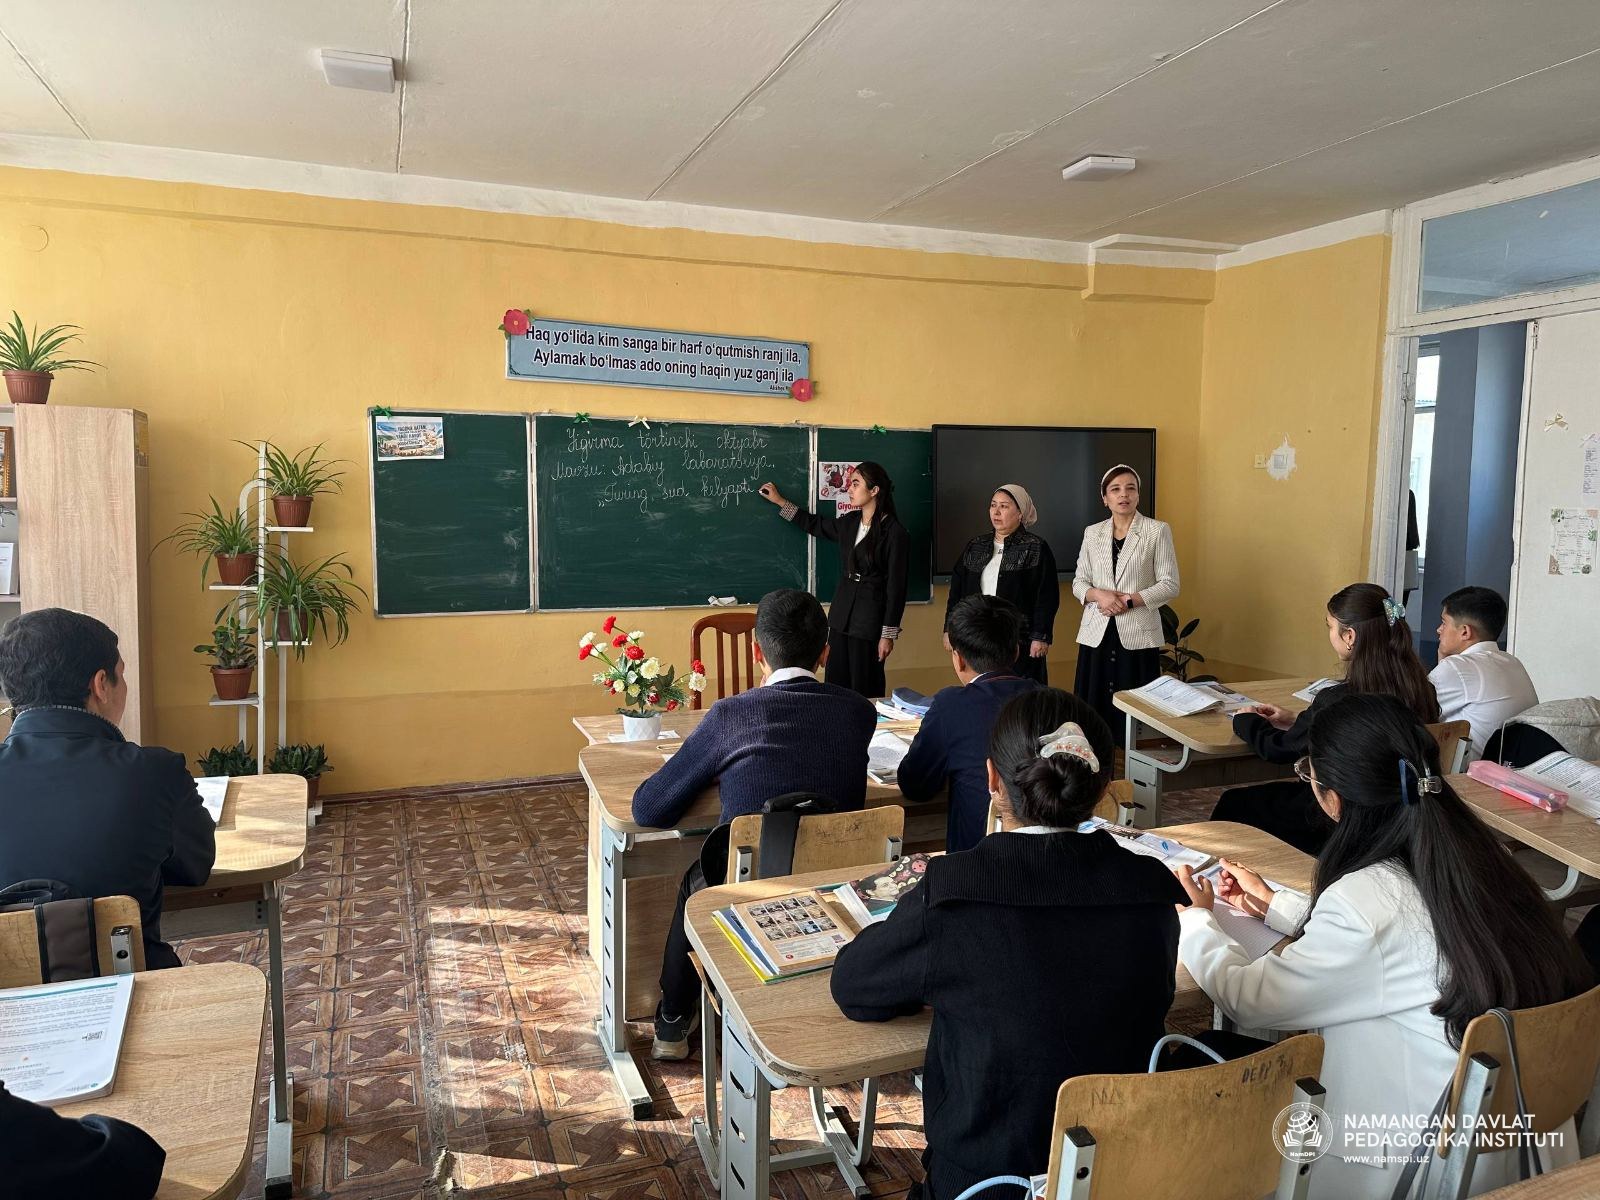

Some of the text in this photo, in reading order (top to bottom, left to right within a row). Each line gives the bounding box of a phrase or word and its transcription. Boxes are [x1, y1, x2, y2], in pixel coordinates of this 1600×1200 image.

[526, 326, 550, 345] Haq
[598, 332, 619, 347] kim
[622, 336, 658, 353] sanga
[661, 338, 676, 352] bir
[680, 340, 703, 355] harf
[762, 349, 783, 364] ranj
[786, 349, 801, 364] ila,
[533, 348, 587, 366] Aylamak
[640, 358, 662, 372] ado
[665, 361, 697, 378] oning
[700, 362, 731, 379] haqin
[734, 367, 753, 381] yuz
[756, 368, 779, 384] ganj
[782, 368, 794, 382] ila
[566, 428, 624, 463] Yigirma
[716, 429, 768, 458] oktyabr
[612, 452, 665, 487] Adabiy
